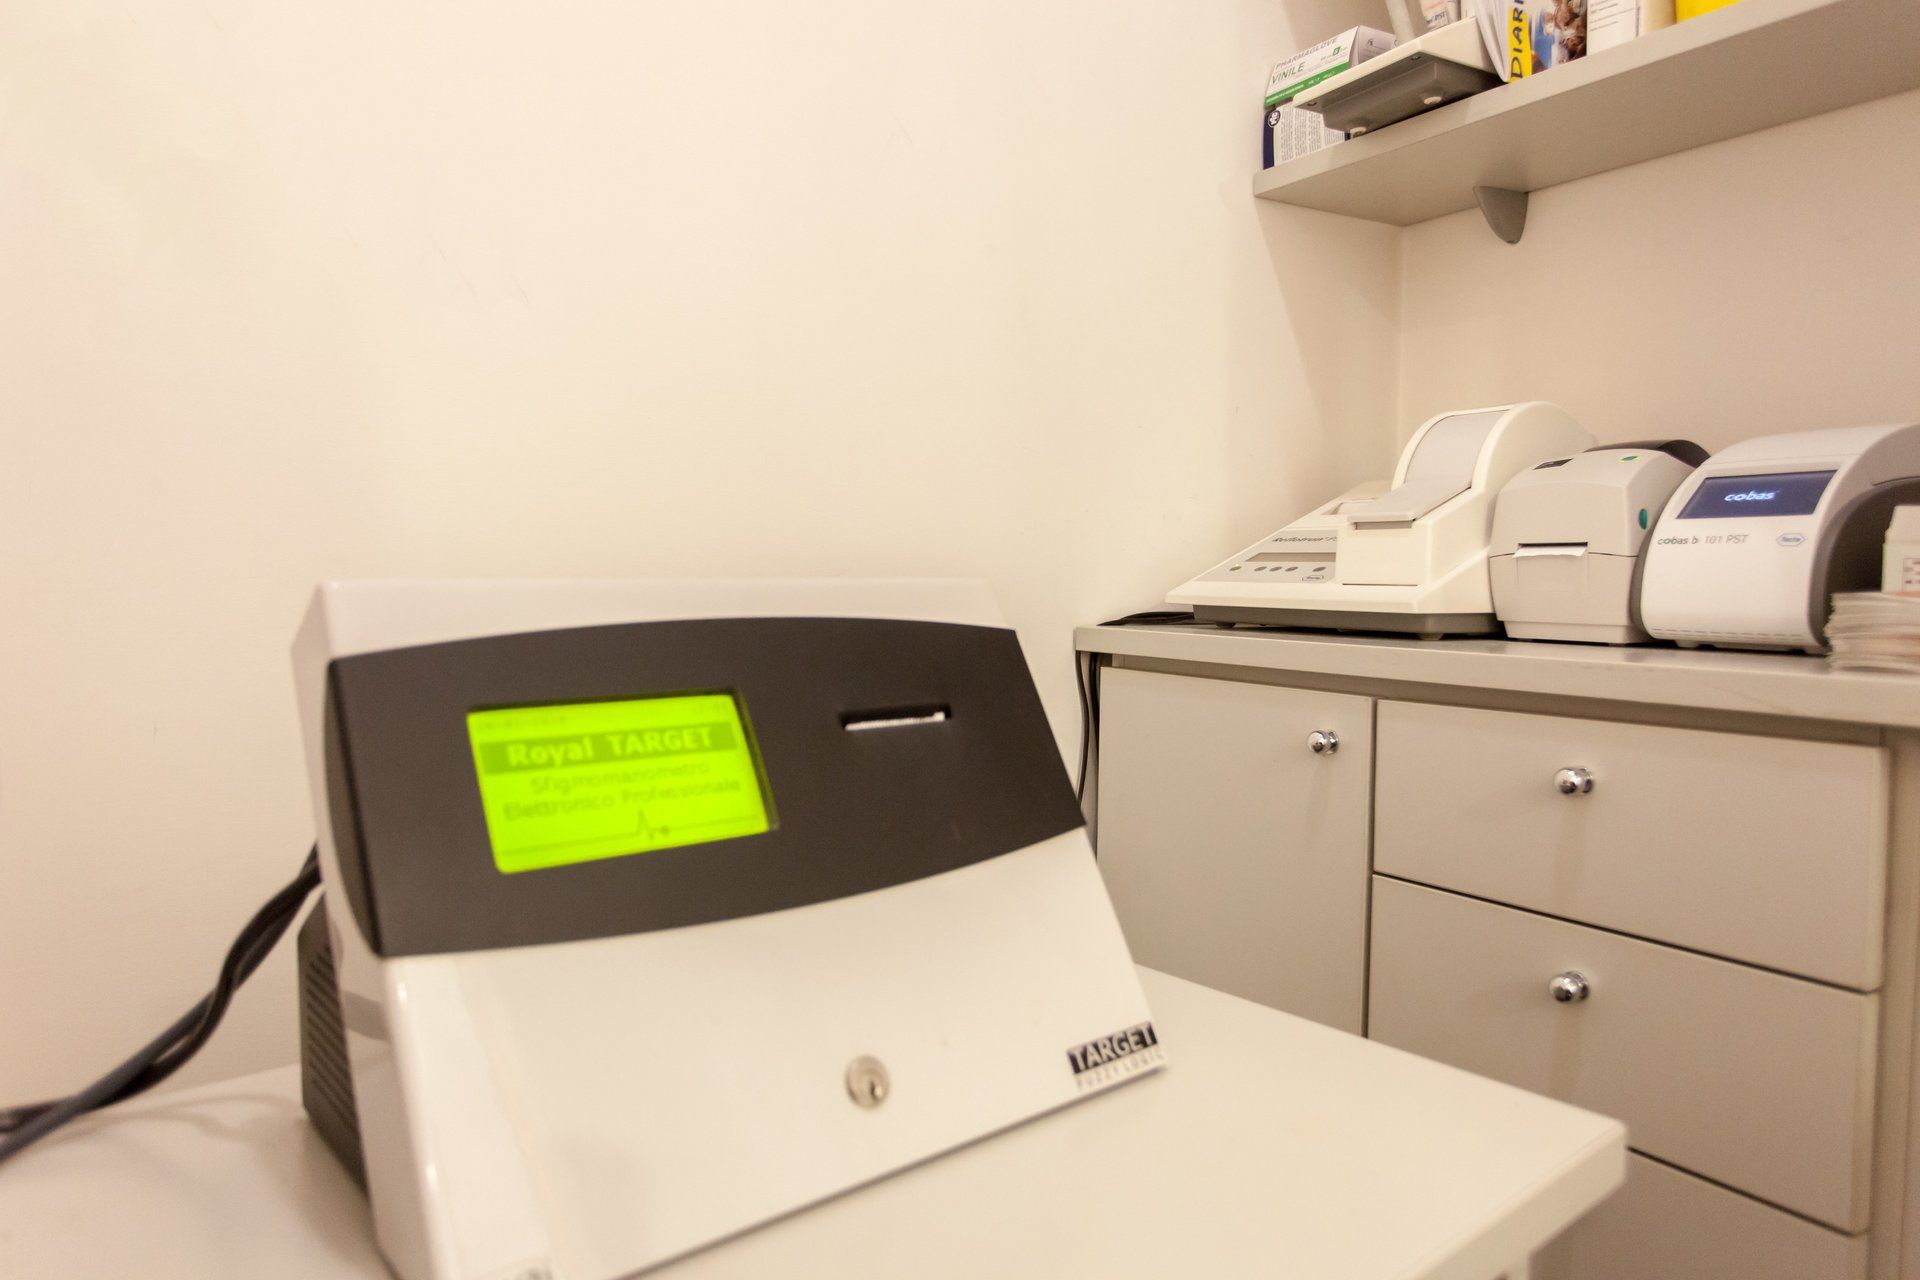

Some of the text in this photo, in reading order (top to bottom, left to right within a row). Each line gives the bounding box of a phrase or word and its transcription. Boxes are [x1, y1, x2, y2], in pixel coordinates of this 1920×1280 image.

[1272, 61, 1306, 84] VINILE
[1724, 490, 1776, 502] cobas
[1657, 534, 1749, 546] cobas b 101 PST
[507, 726, 713, 768] Royal TARGET
[502, 792, 615, 822] Elettronico
[1066, 1021, 1157, 1074] TARGET
